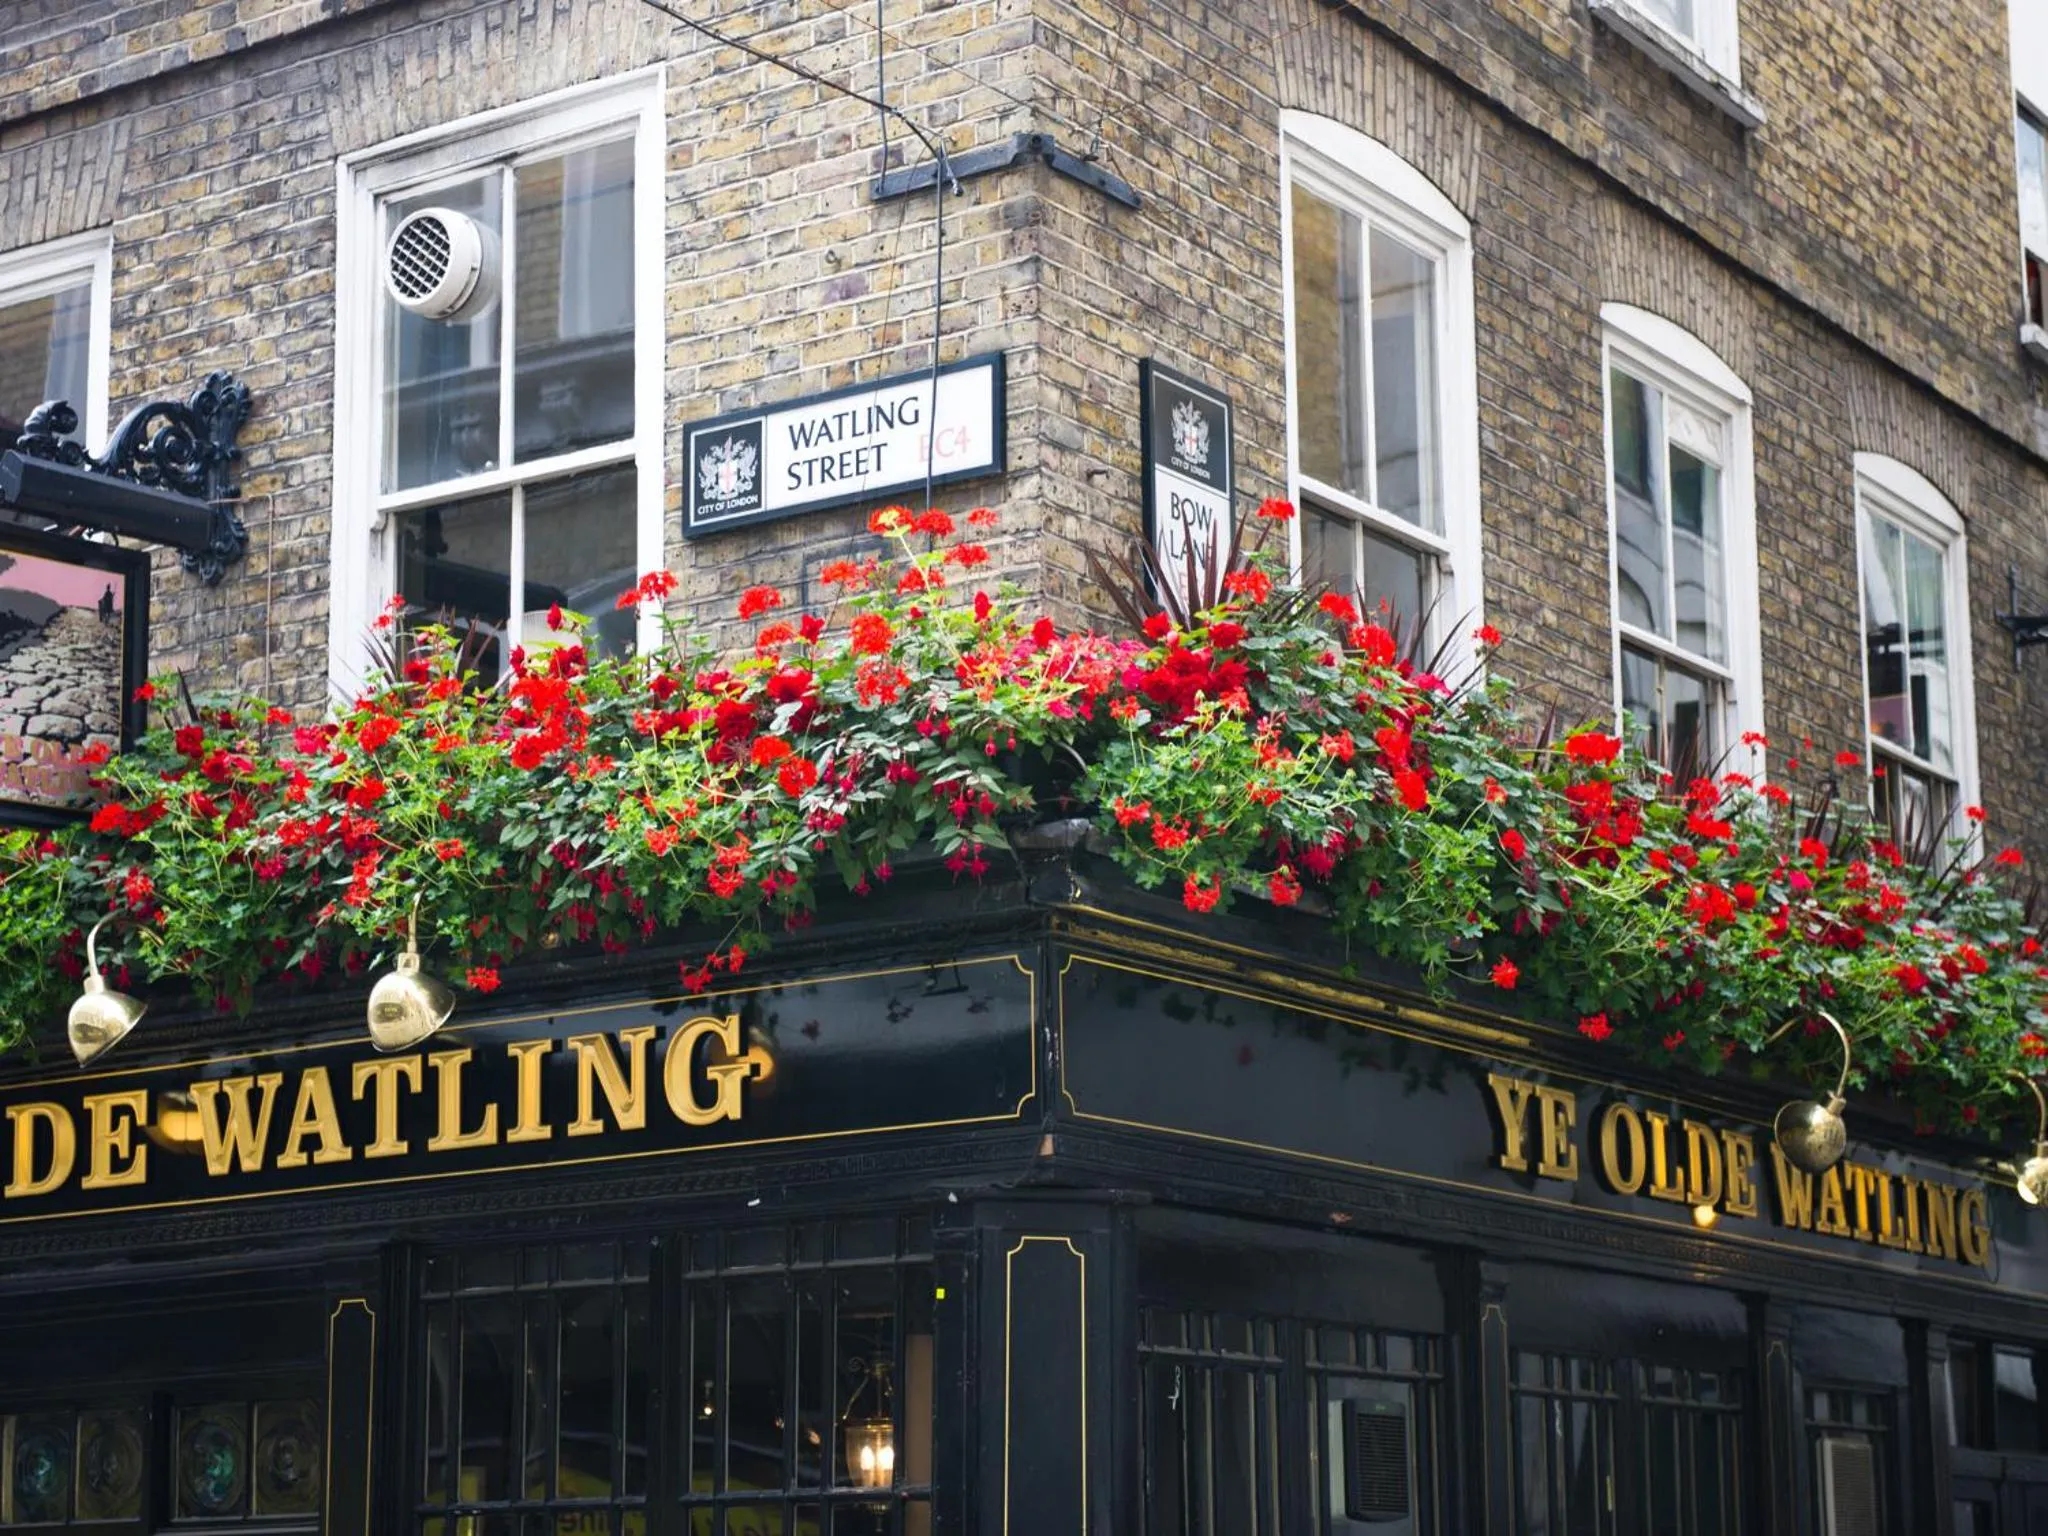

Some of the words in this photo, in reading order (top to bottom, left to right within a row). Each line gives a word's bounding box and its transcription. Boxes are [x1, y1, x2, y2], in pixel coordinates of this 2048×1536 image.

[788, 396, 920, 451] WATLING
[918, 425, 971, 463] EC4
[787, 442, 888, 491] STREET
[697, 503, 714, 515] CITY
[715, 501, 725, 511] OF
[727, 494, 759, 509] LONDON
[1170, 492, 1213, 533] BOW
[1170, 529, 1215, 572] LAN
[4, 1089, 148, 1198] DE
[189, 1013, 750, 1176] WATLING
[1488, 1073, 1578, 1181] YE
[1601, 1102, 1757, 1217] OLDE
[1769, 1140, 1990, 1267] WATLING
